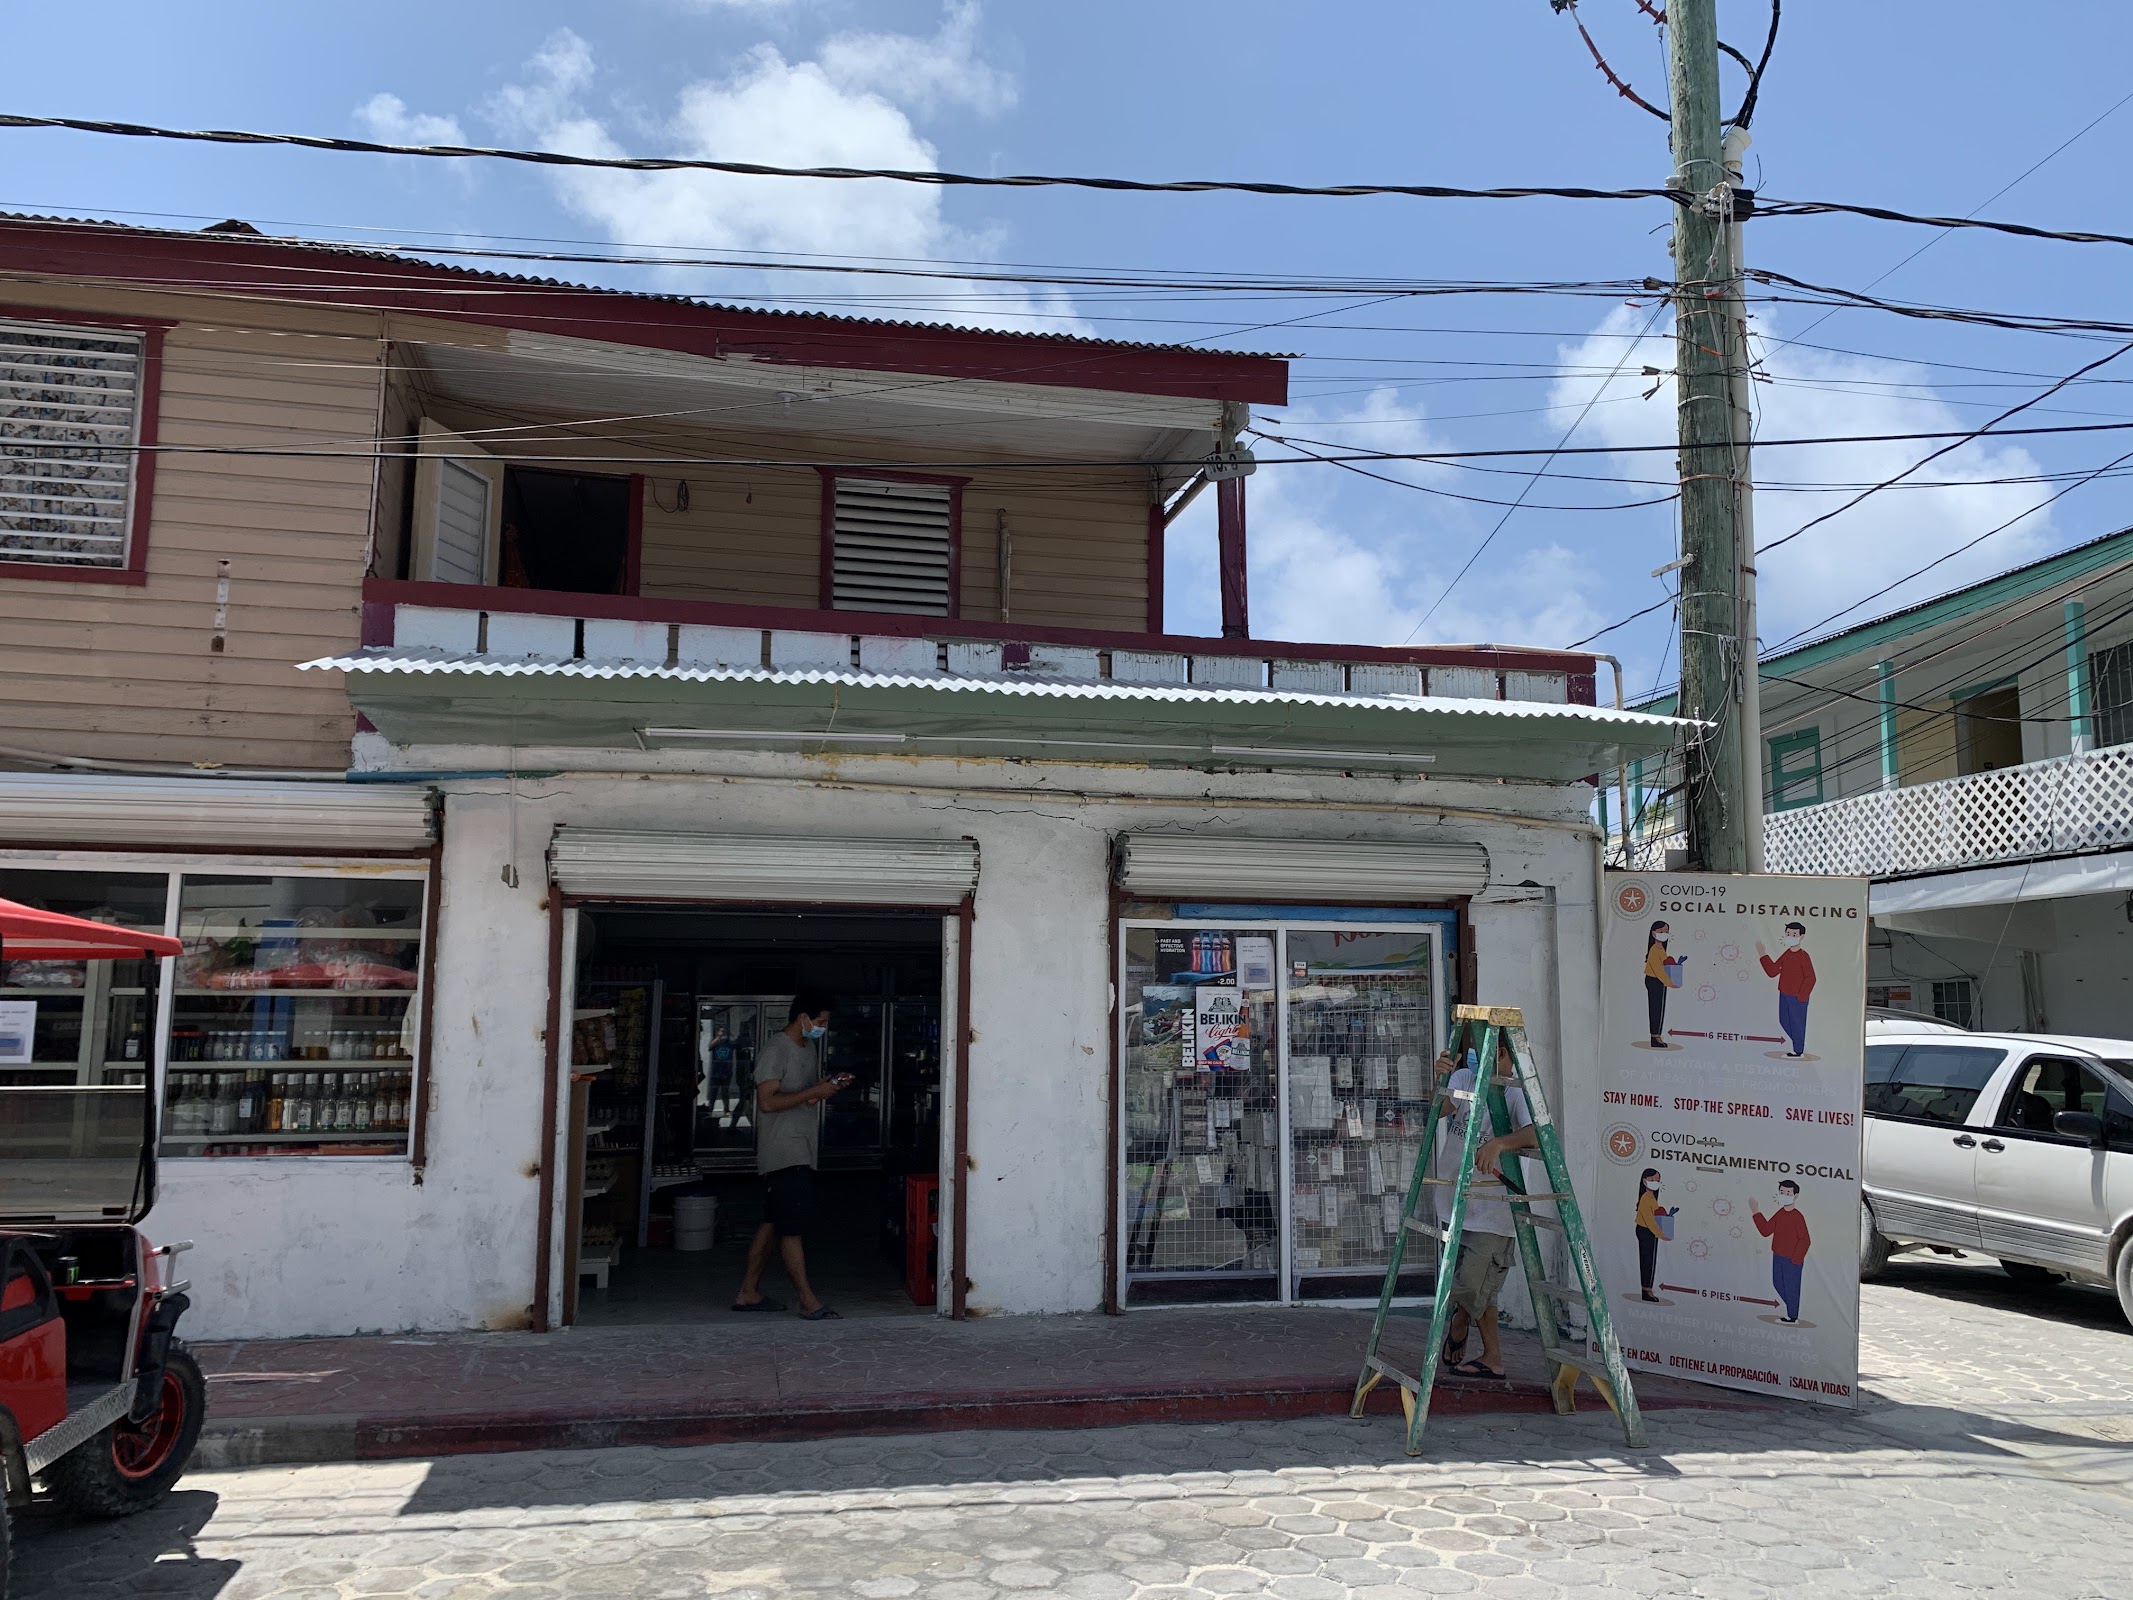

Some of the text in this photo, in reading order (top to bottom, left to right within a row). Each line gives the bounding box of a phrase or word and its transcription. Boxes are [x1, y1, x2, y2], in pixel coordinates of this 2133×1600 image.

[1660, 885, 1726, 897] COVID-19
[1659, 901, 1858, 919] SOCIAL DISTANCING
[1200, 1014, 1246, 1025] BELIKIN
[1182, 1008, 1195, 1067] BELIKIN
[1708, 1031, 1740, 1041] 6 FEET
[1735, 1063, 1800, 1078] DISTANCE
[1603, 1091, 1854, 1126] STAY HOME. STOP THE SPREAD. SAVE LIVES!
[1650, 1148, 1854, 1180] DISTANCIAMIENTO SOCIAL
[1701, 1289, 1731, 1301] 6 PIES
[1627, 1348, 1638, 1359] EN
[1640, 1350, 1662, 1364] CASA.
[1669, 1355, 1705, 1372] DETIENE
[1707, 1362, 1717, 1374] LA
[1720, 1364, 1781, 1386] PROPAGACIÓN.
[1789, 1376, 1818, 1391] ¡SALVA
[1821, 1381, 1850, 1397] VIDAS!
